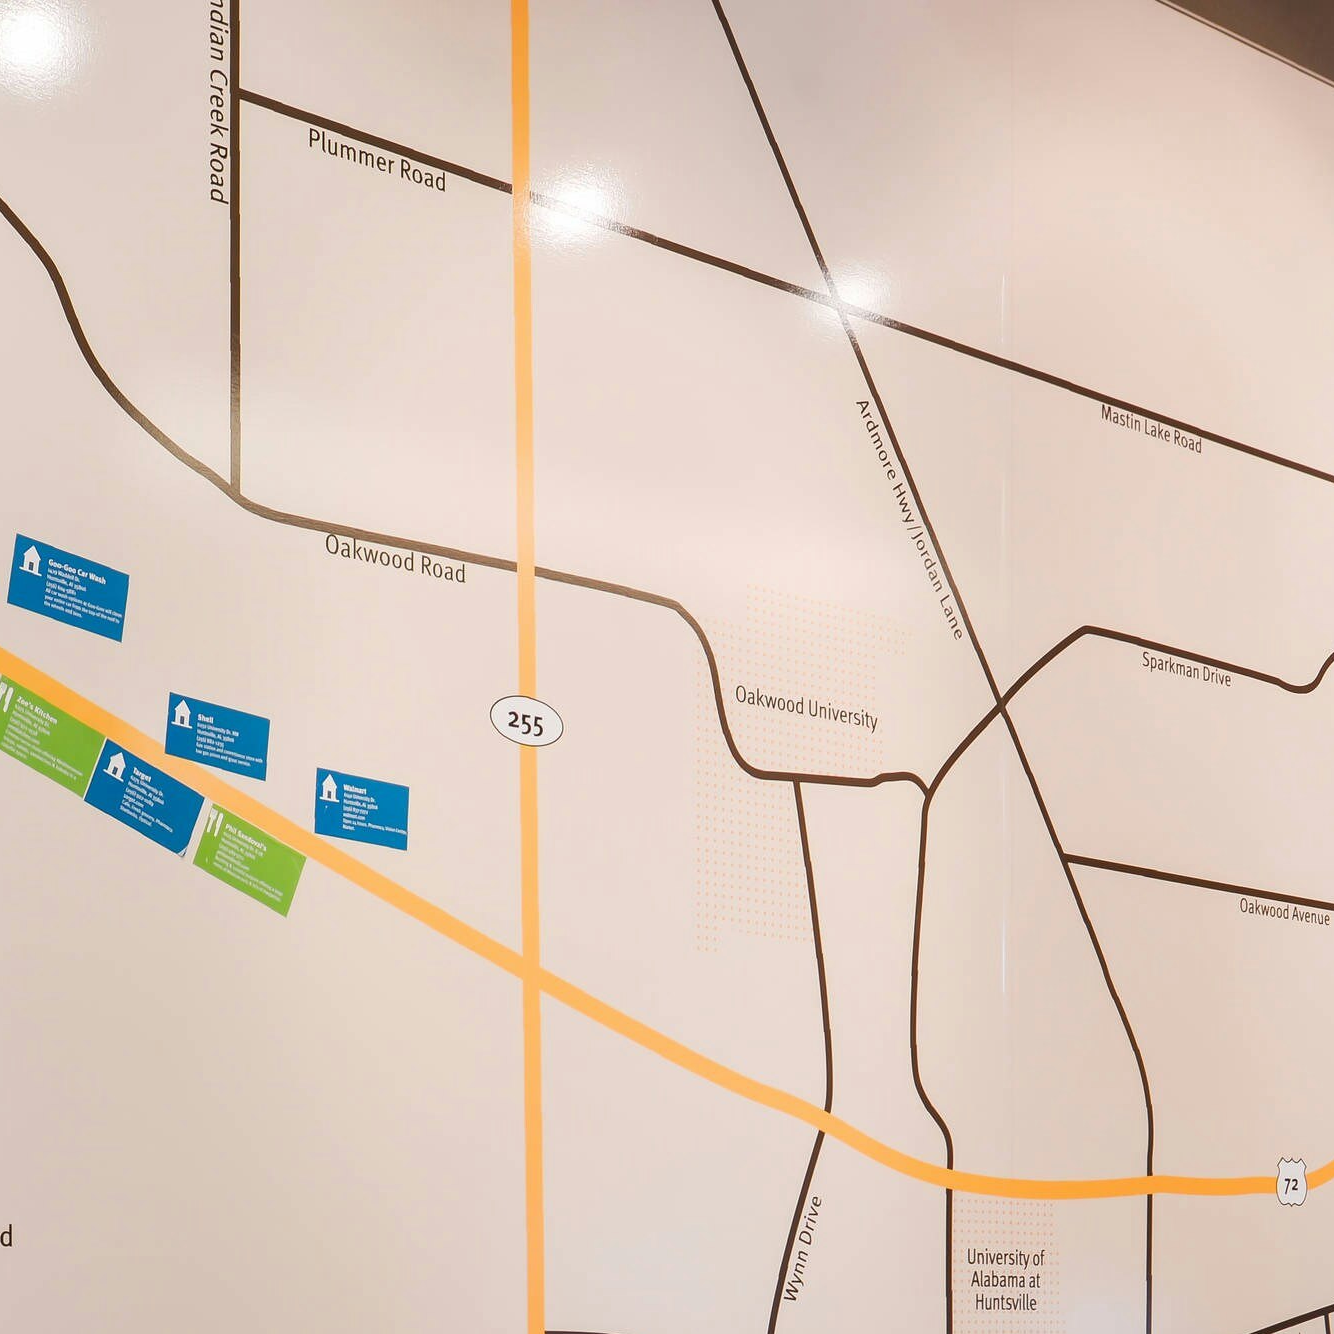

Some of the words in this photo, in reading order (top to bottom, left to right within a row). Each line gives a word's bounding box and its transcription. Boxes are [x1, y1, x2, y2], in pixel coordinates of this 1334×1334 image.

[210, 0, 229, 61] ndian
[210, 69, 229, 137] Creek
[210, 142, 229, 205] Road
[308, 127, 395, 177] Plummer
[399, 159, 447, 193] Road
[1100, 403, 1143, 433] Mastin
[1143, 417, 1172, 444] Lake
[1173, 429, 1203, 455] Road
[856, 399, 896, 481] Ardmore
[939, 594, 963, 641] Lane
[77, 568, 88, 578] Car
[89, 572, 107, 585] Wash
[324, 533, 416, 574] Oakwood
[420, 554, 467, 585] Road
[1142, 651, 1200, 681] Sparkman
[1202, 665, 1232, 688] Drive
[507, 710, 544, 738] 255
[735, 684, 805, 716] Oakwood
[808, 699, 879, 735] University
[1239, 897, 1290, 923] Oakwood
[1292, 905, 1331, 927] Avenue
[1284, 1178, 1299, 1195] 72
[783, 1246, 808, 1302] Wynn
[798, 1195, 822, 1246] Drive
[967, 1247, 1030, 1270] University
[1032, 1248, 1046, 1267] of
[971, 1270, 1026, 1289] Alabama
[1029, 1273, 1041, 1289] at
[975, 1293, 1037, 1312] Huntsville
